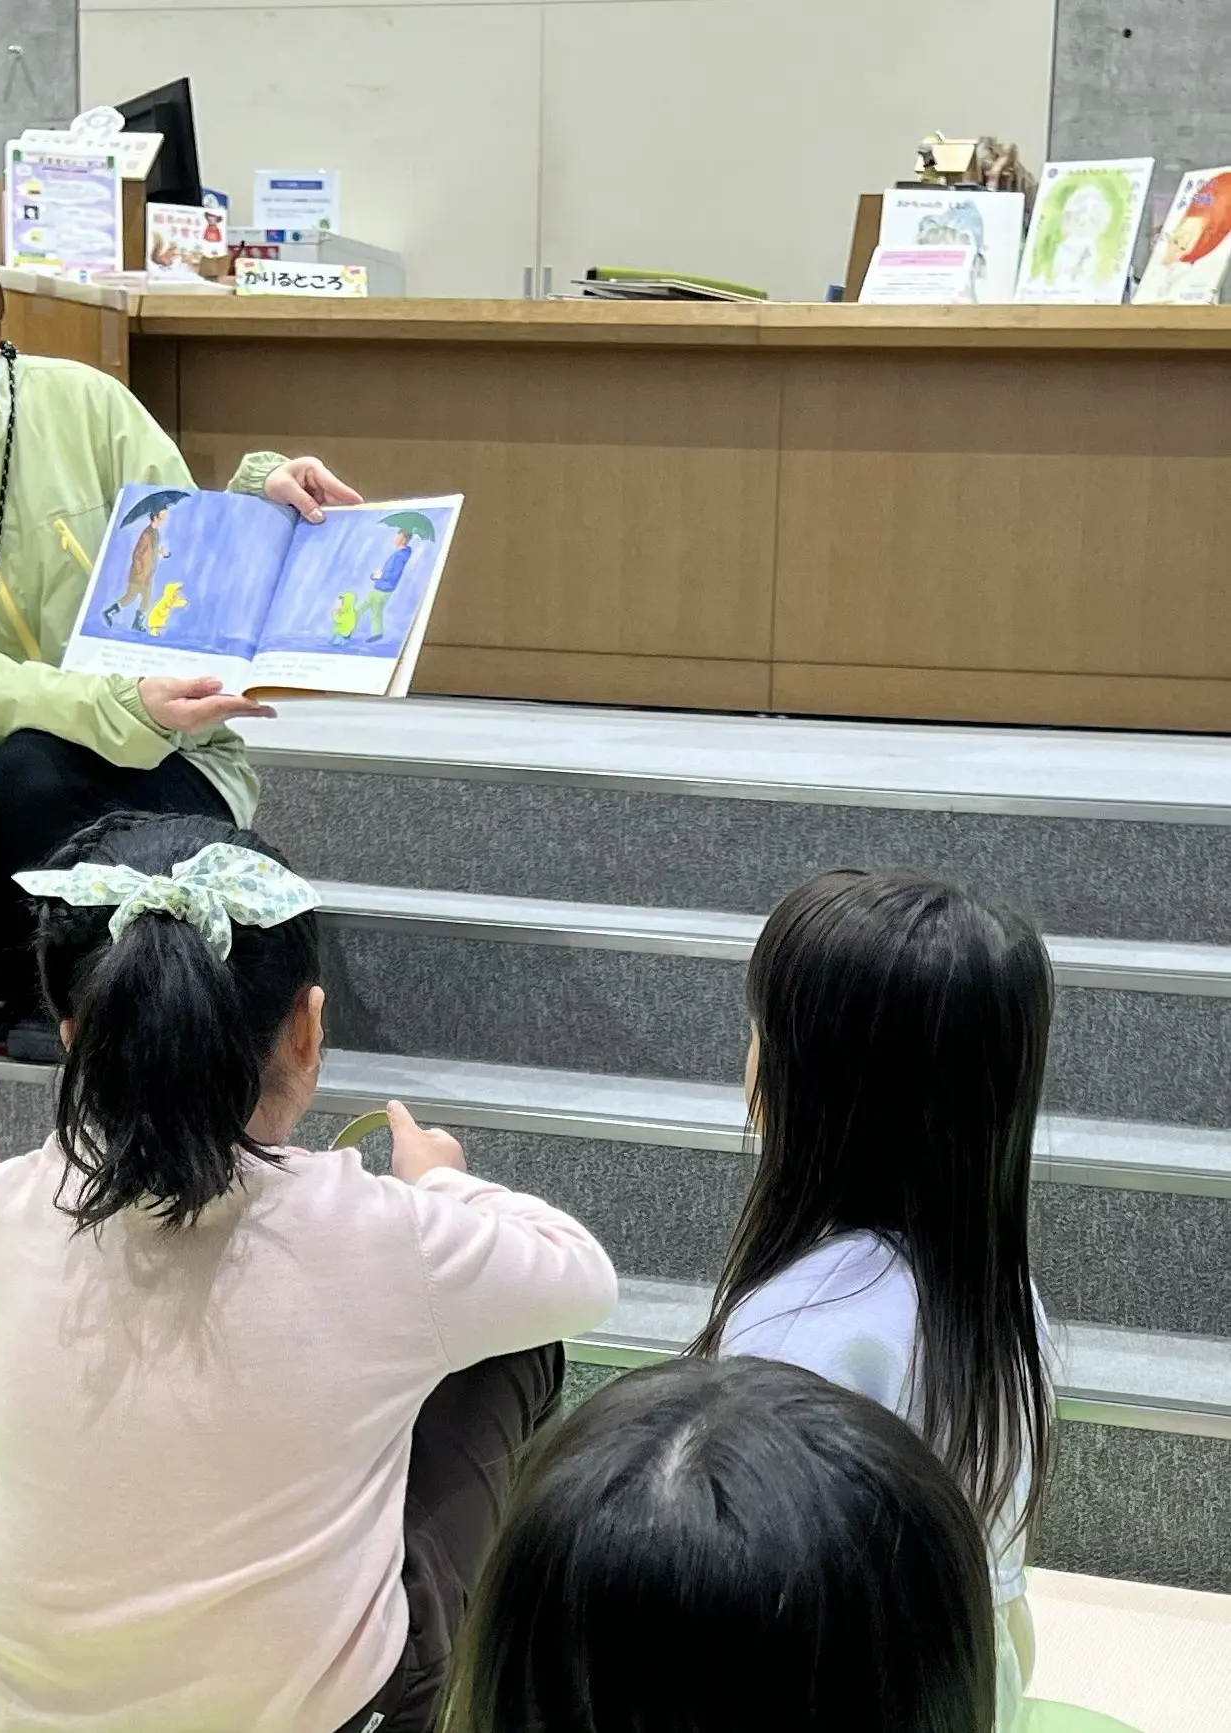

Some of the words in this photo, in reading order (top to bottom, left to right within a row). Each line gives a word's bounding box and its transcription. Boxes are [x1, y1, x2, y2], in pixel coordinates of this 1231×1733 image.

[244, 270, 343, 291] かりるところ
